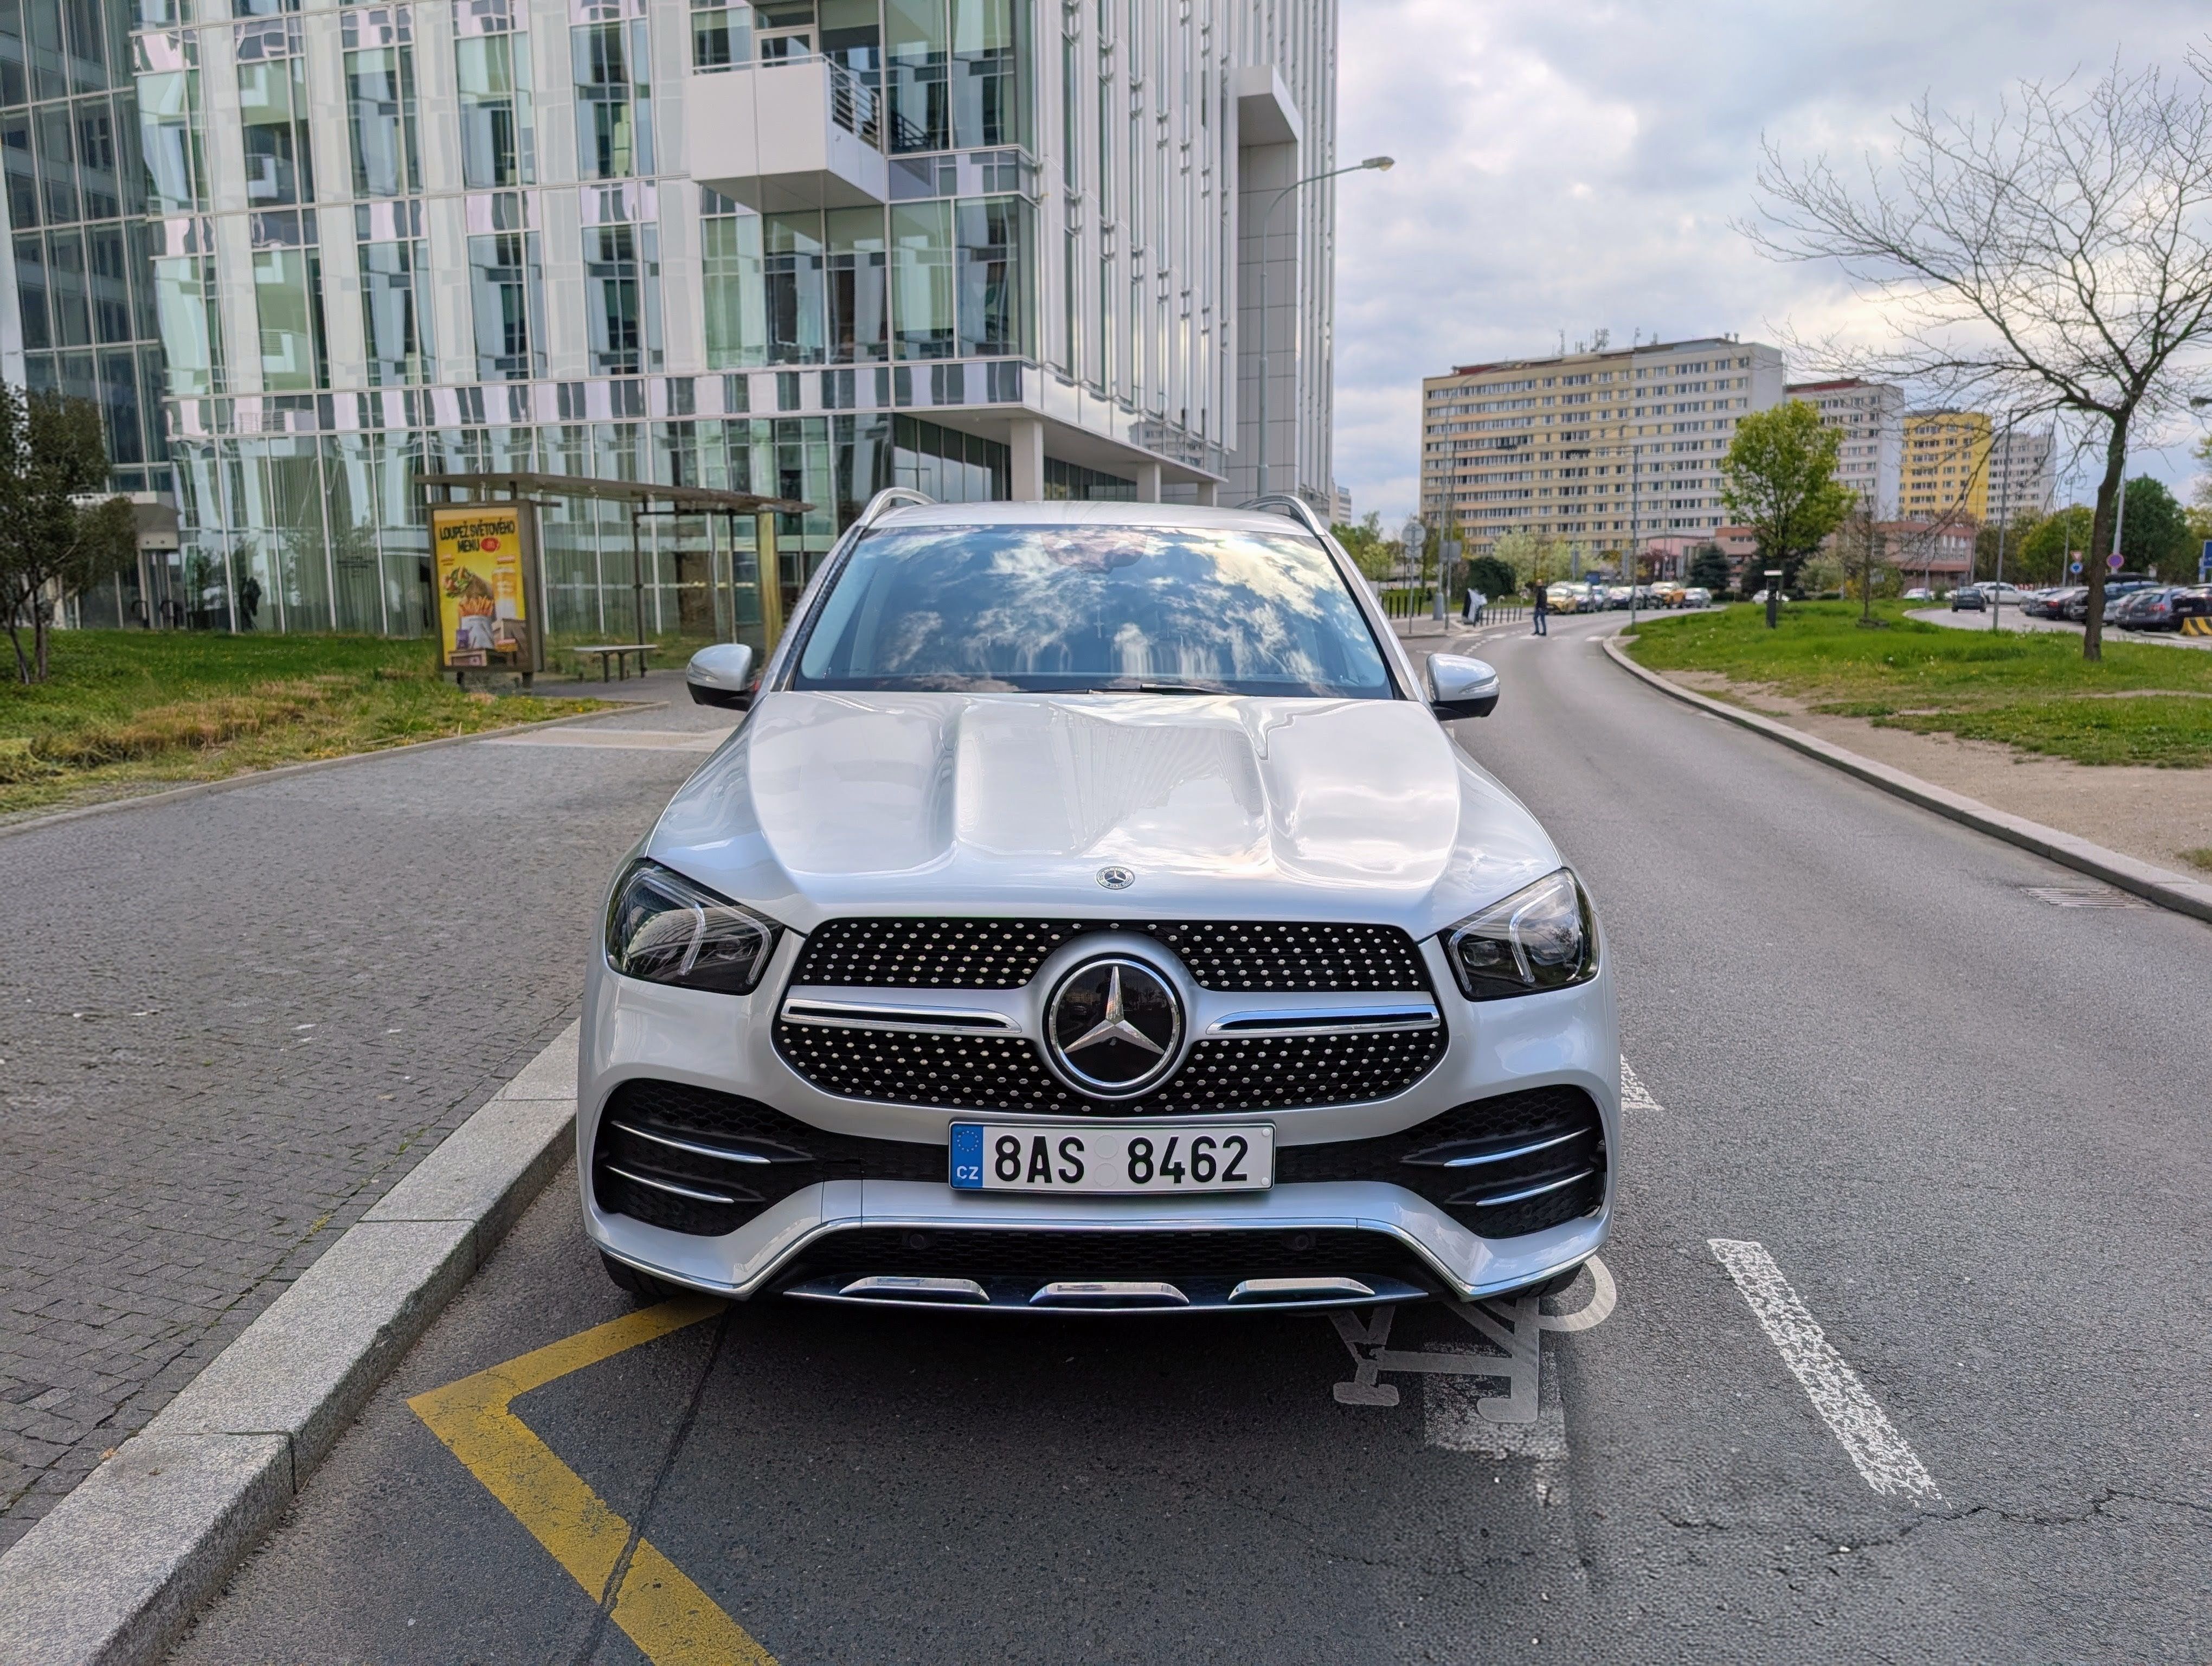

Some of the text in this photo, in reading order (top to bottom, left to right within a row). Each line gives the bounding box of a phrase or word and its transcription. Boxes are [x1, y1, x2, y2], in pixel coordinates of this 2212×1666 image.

[440, 520, 470, 540] LOUPEŽ
[458, 538, 480, 553] MENU
[994, 1134, 1249, 1184] 8AS 8462
[956, 1165, 979, 1180] CZ
